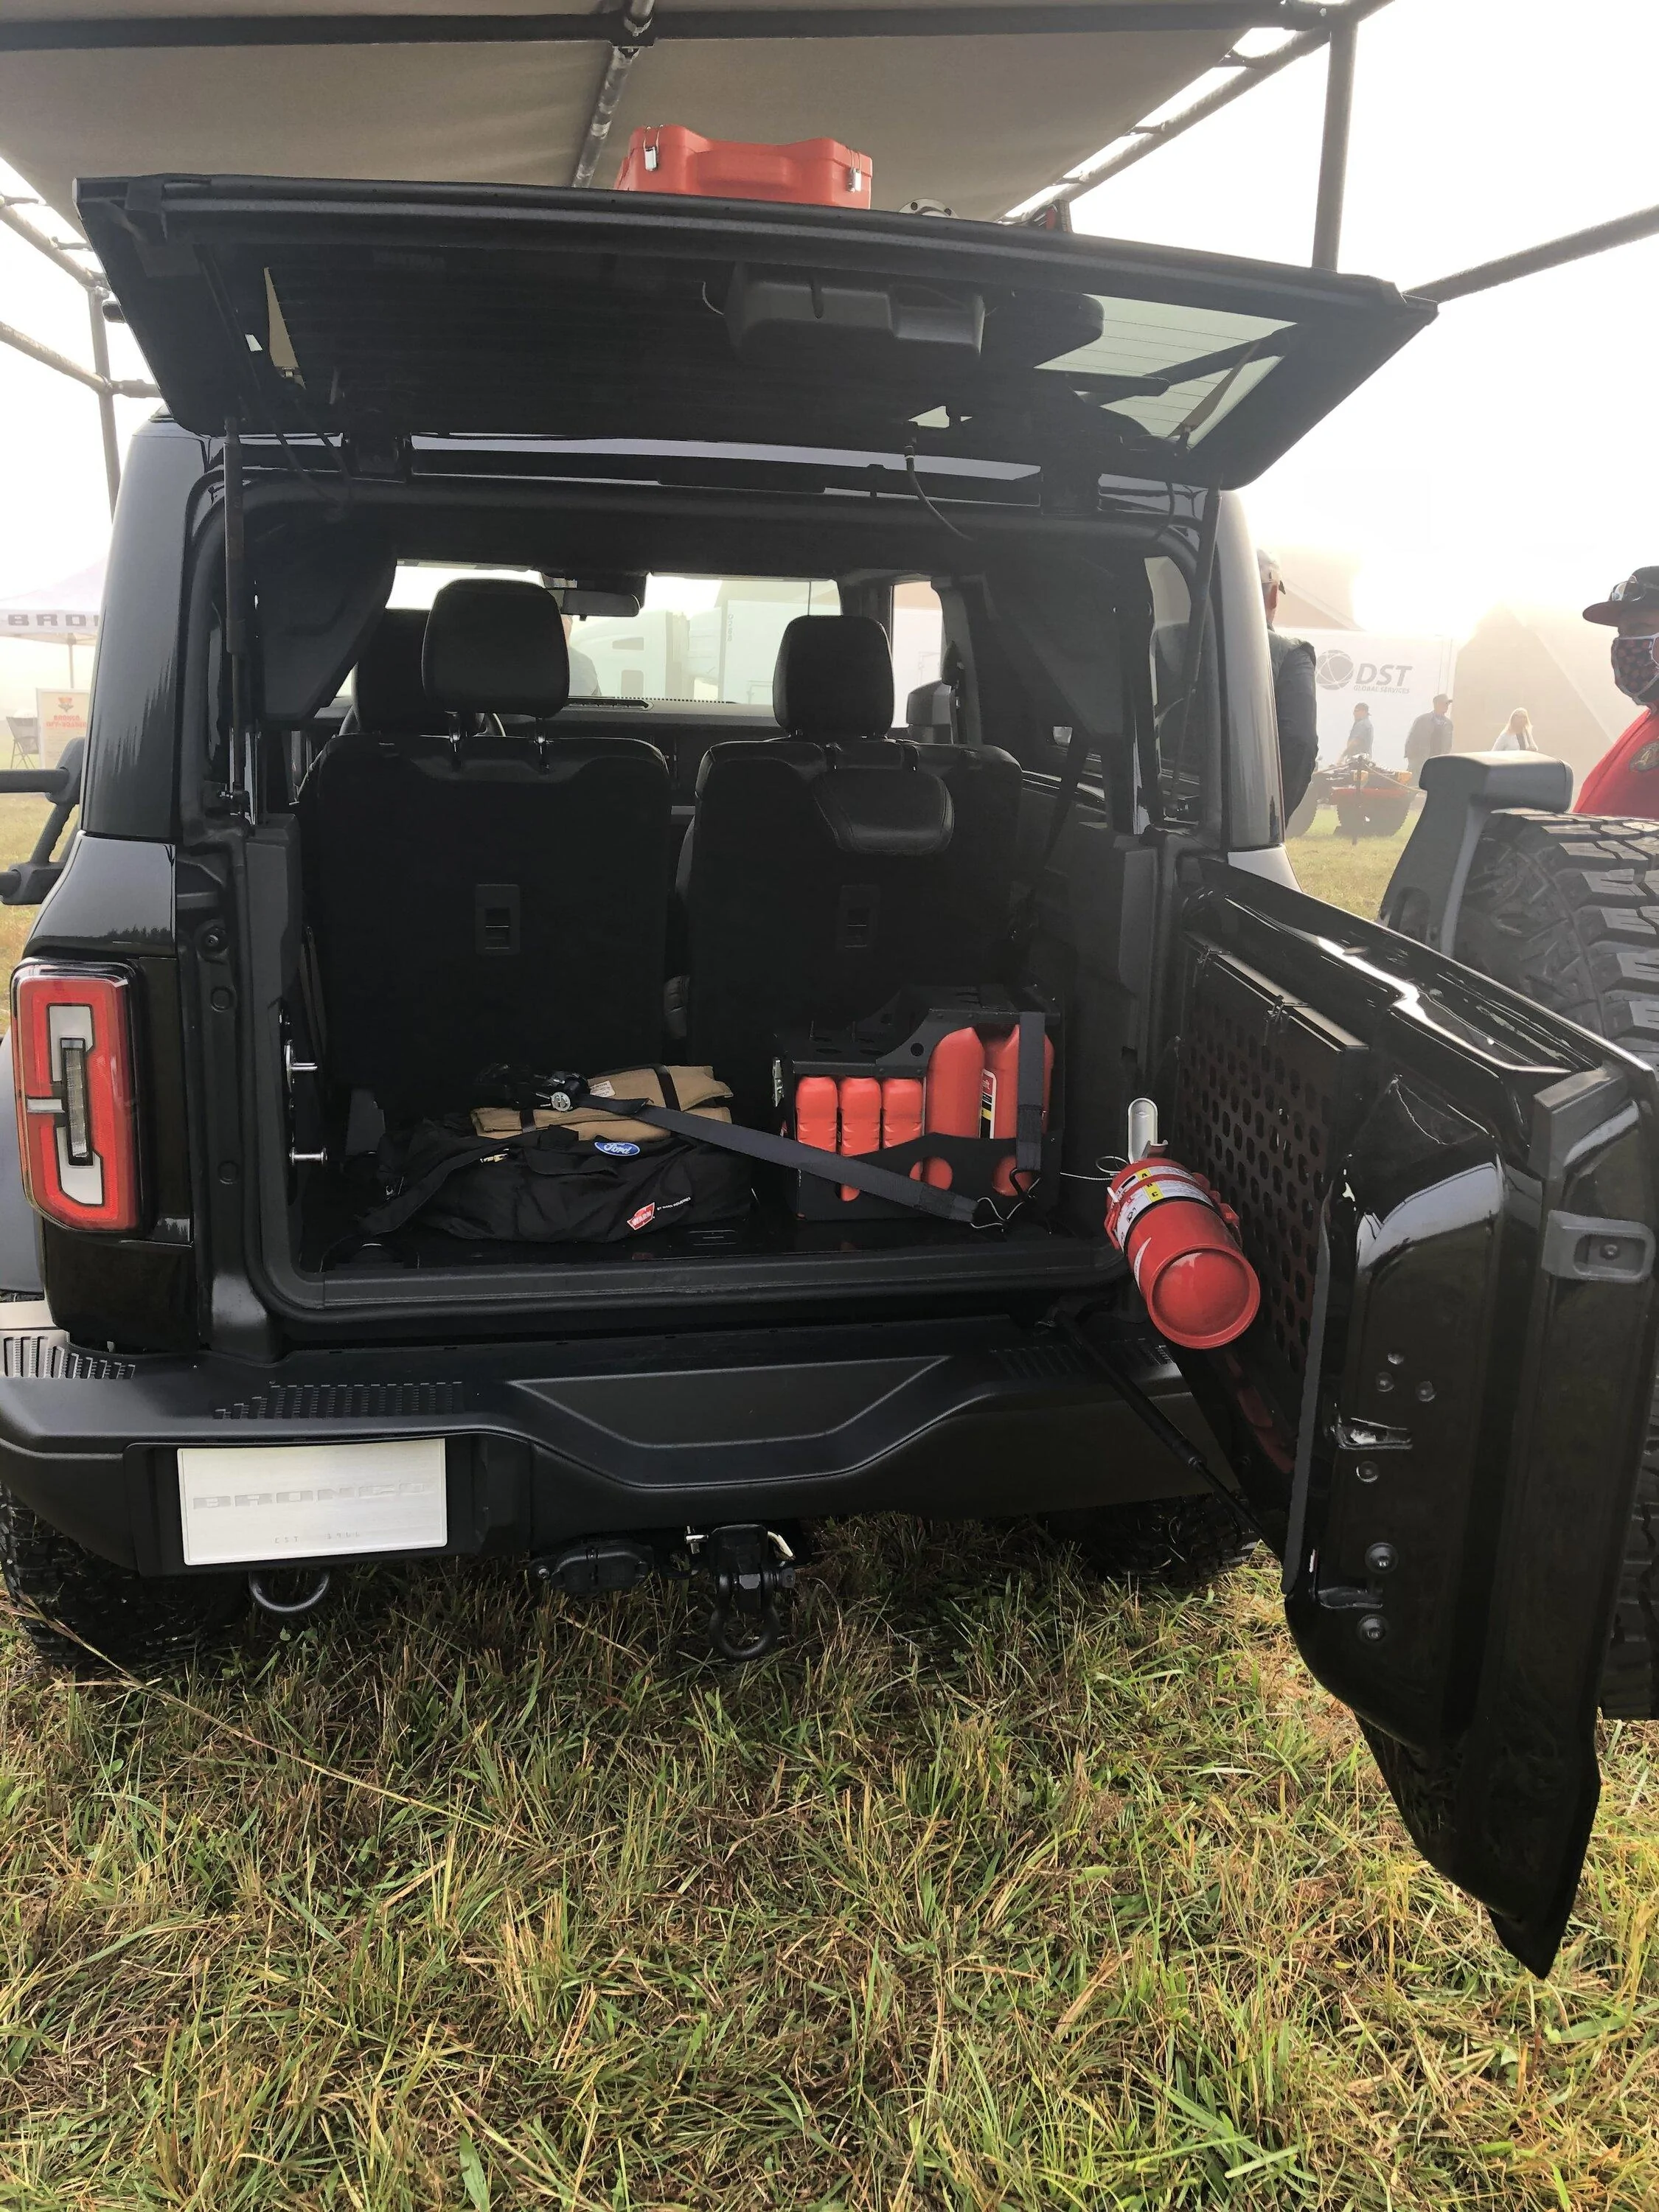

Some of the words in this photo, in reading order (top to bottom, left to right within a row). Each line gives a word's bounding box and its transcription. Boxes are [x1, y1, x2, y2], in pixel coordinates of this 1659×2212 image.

[8, 613, 100, 627] BRO
[1355, 663, 1413, 686] DST
[1354, 684, 1378, 692] GLOBAL
[1380, 686, 1410, 695] SERVICES
[603, 1142, 633, 1155] Ford
[632, 1210, 652, 1226] WARN
[193, 1483, 425, 1509] BRONCO
